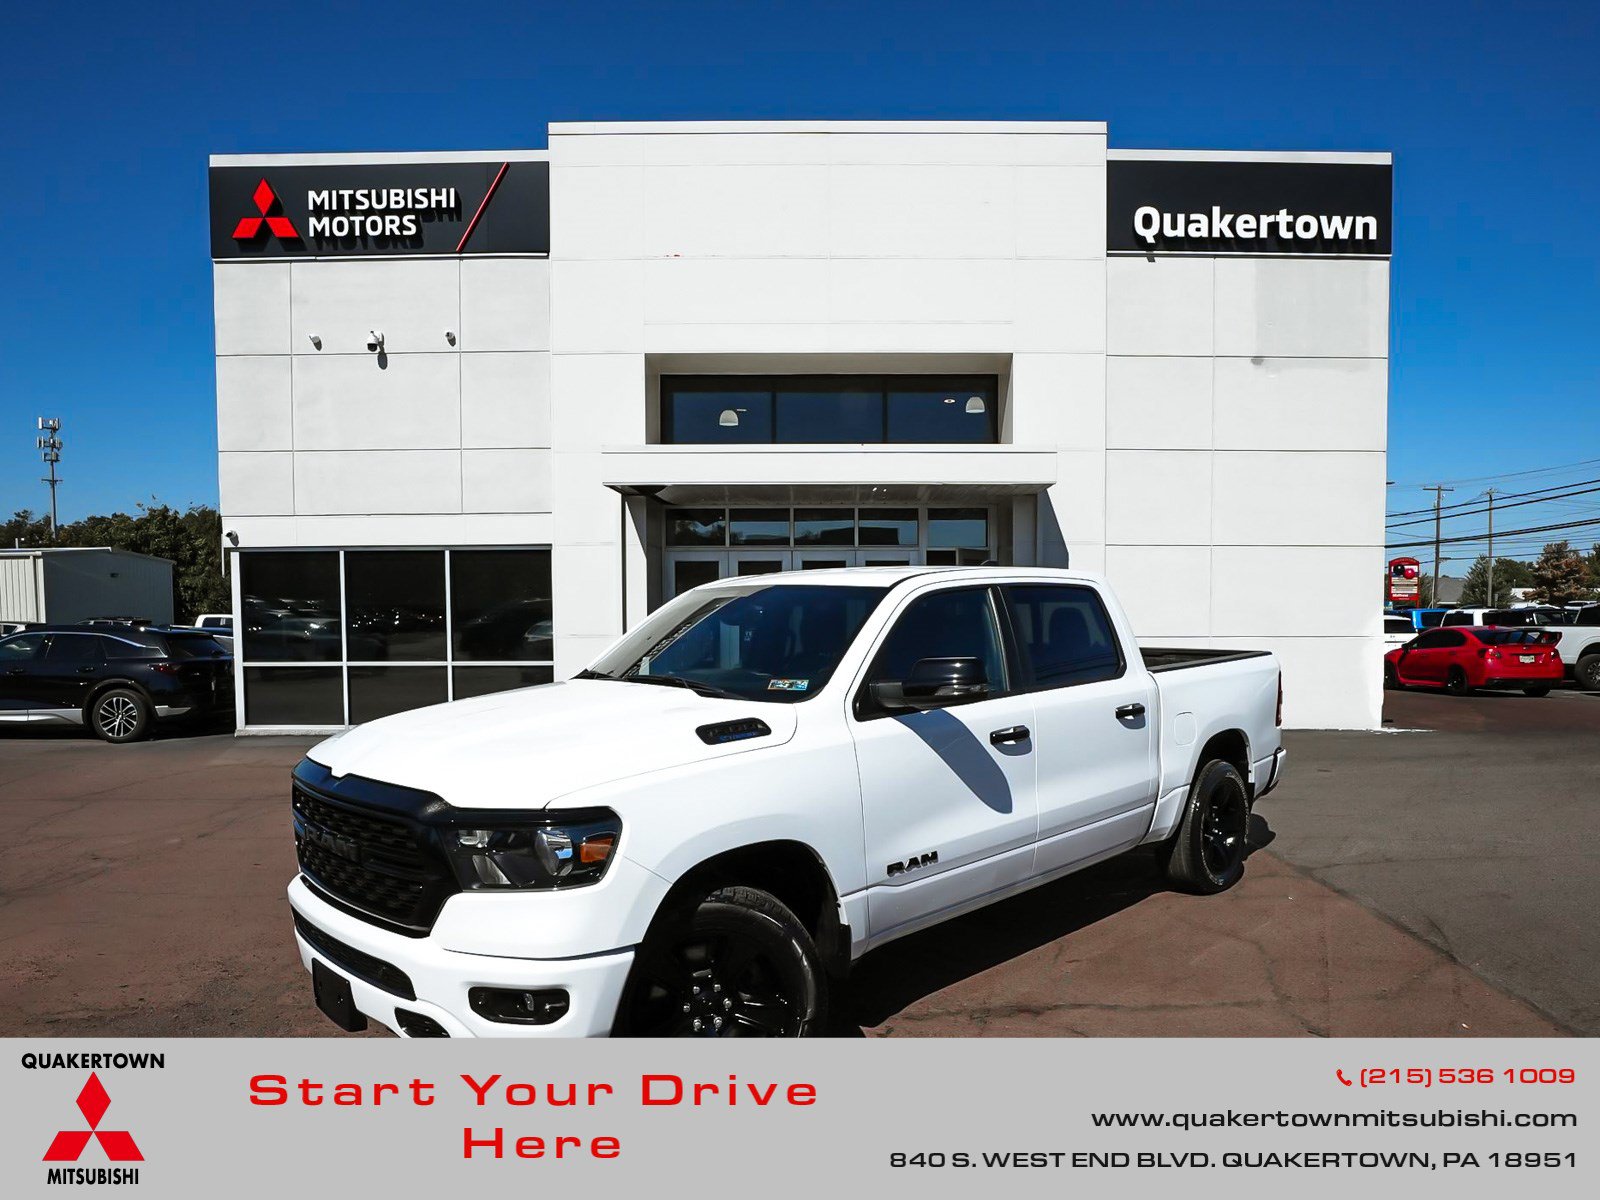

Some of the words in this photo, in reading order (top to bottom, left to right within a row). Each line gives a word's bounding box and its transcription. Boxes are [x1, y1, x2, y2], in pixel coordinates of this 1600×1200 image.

[308, 187, 455, 211] MITSUBISHI
[308, 214, 417, 237] MOTORS
[1133, 205, 1378, 244] Quakertown
[886, 850, 939, 876] RAM
